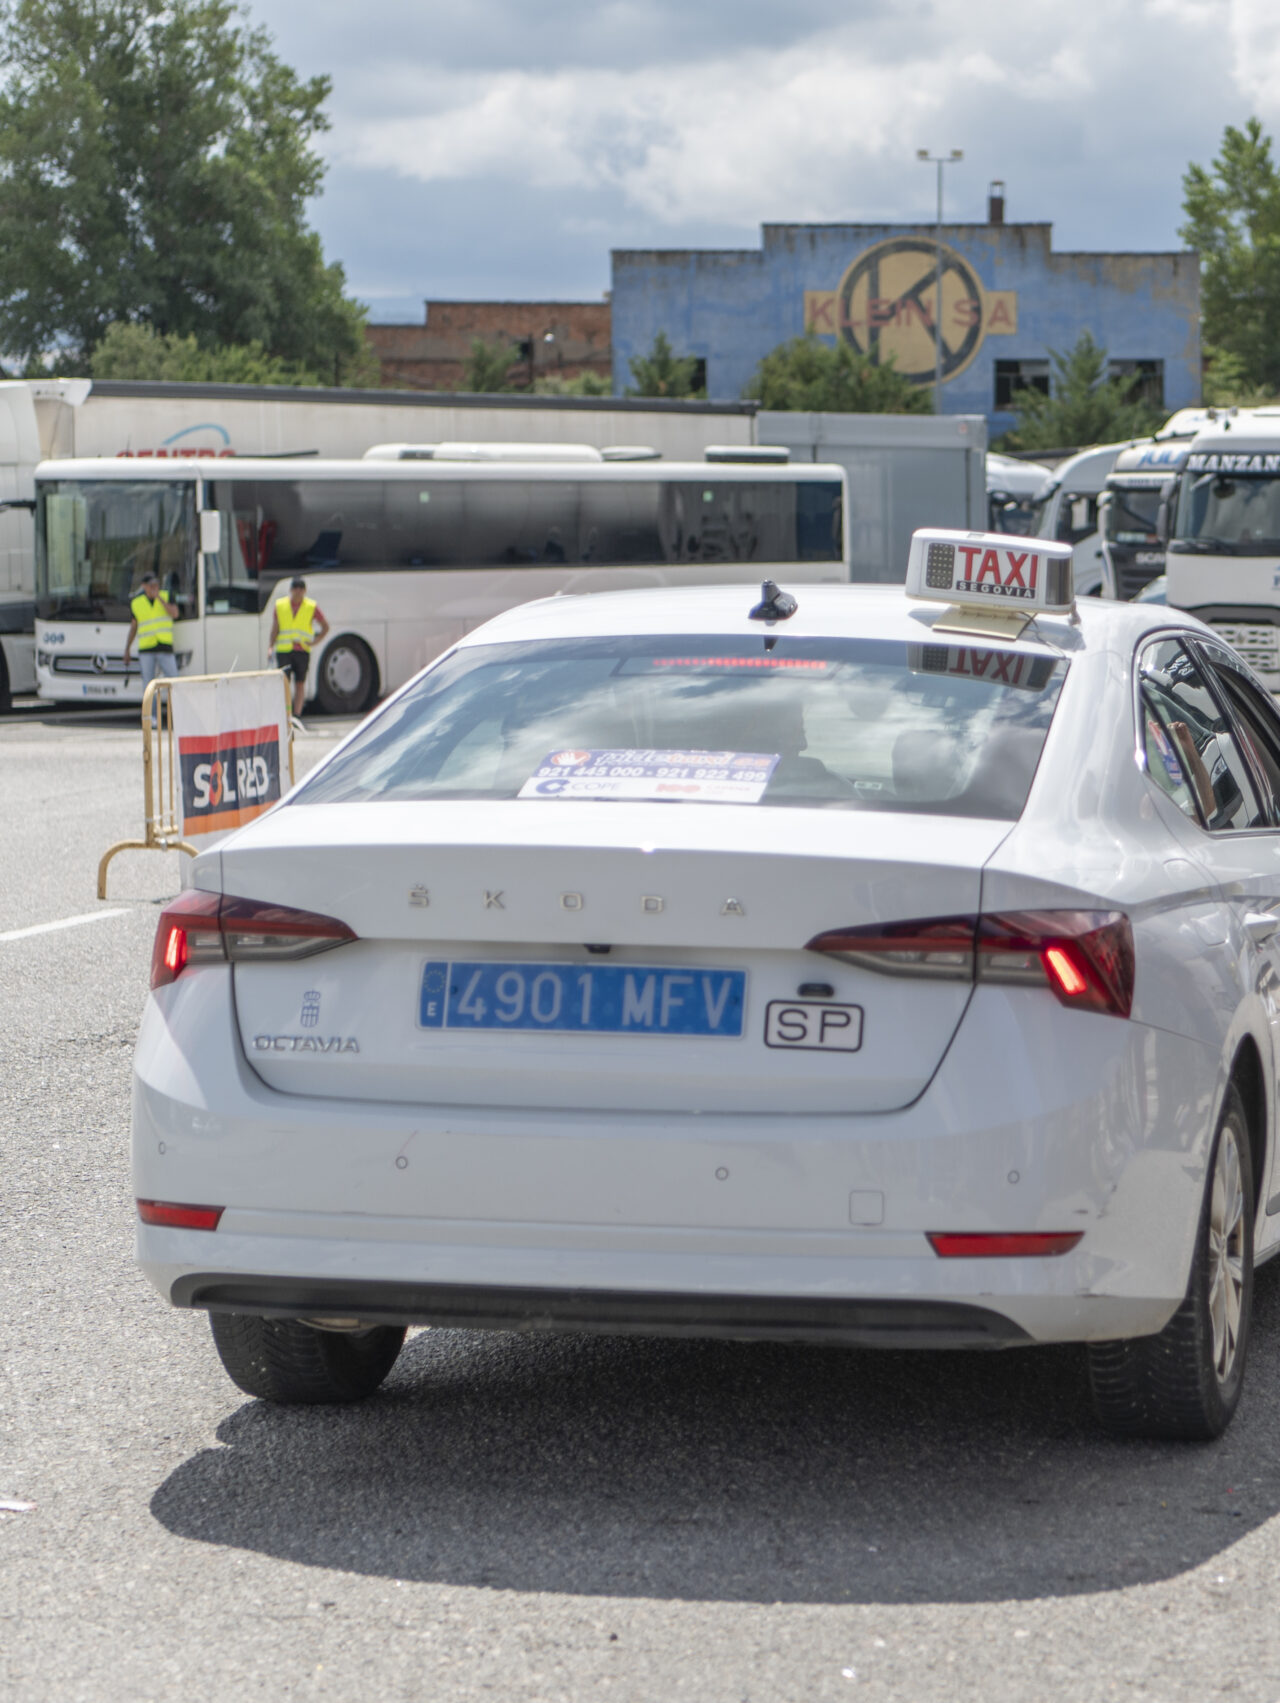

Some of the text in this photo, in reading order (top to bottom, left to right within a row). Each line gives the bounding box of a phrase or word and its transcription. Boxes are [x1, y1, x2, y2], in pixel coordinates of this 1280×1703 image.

[951, 298, 1013, 329] SA
[958, 545, 1038, 589] TAXI
[959, 582, 1033, 598] SEGOVIA
[537, 766, 570, 777] 921
[573, 766, 609, 777] 445
[609, 766, 644, 777] 000
[656, 767, 688, 778] 921
[427, 970, 733, 1029] E 4901 MFV
[777, 1008, 851, 1043] SP
[254, 1034, 360, 1053] OCTAVIA
